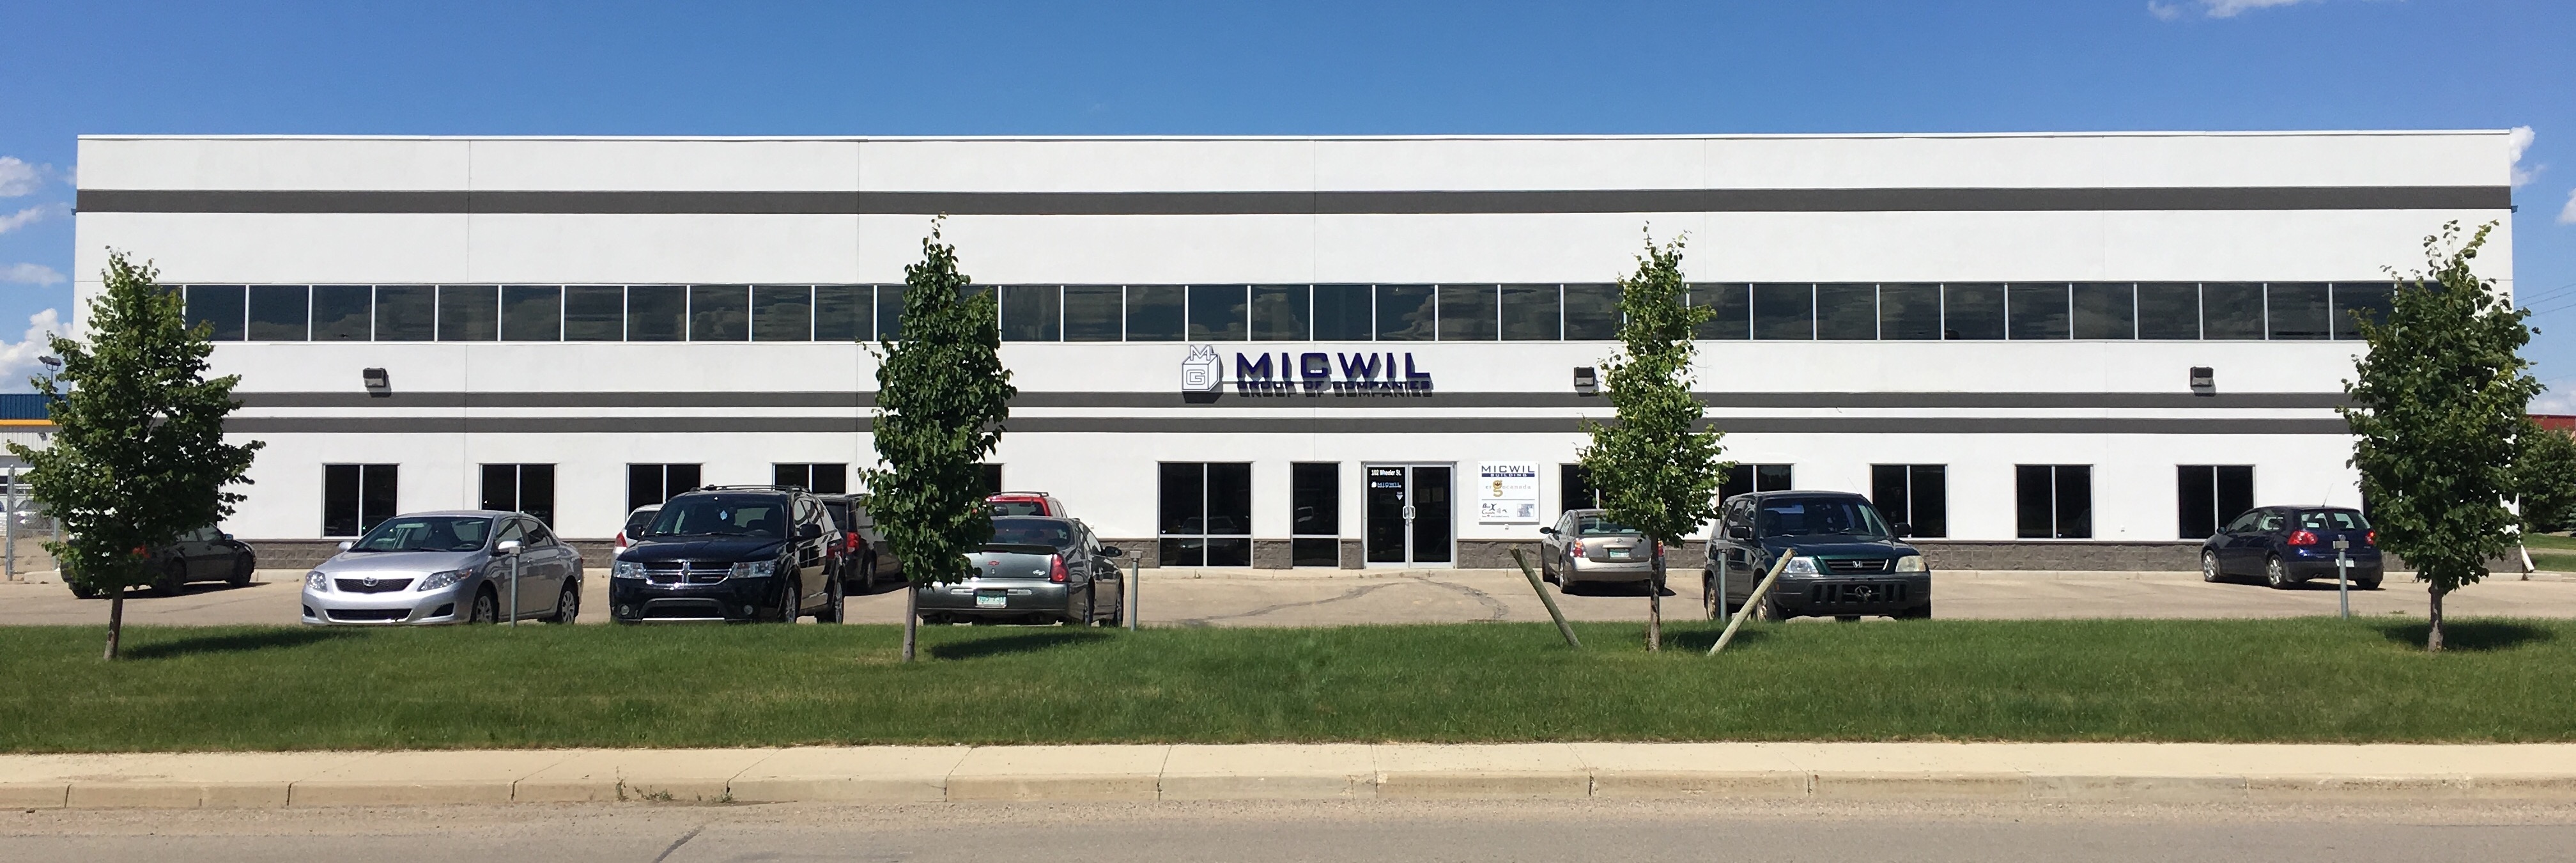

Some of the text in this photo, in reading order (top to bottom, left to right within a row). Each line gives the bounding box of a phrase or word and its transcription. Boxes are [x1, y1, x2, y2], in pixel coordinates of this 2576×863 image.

[1190, 345, 1211, 361] M
[1237, 352, 1430, 378] MICWIL
[1186, 369, 1206, 385] G
[1485, 479, 1531, 497] ergocanada
